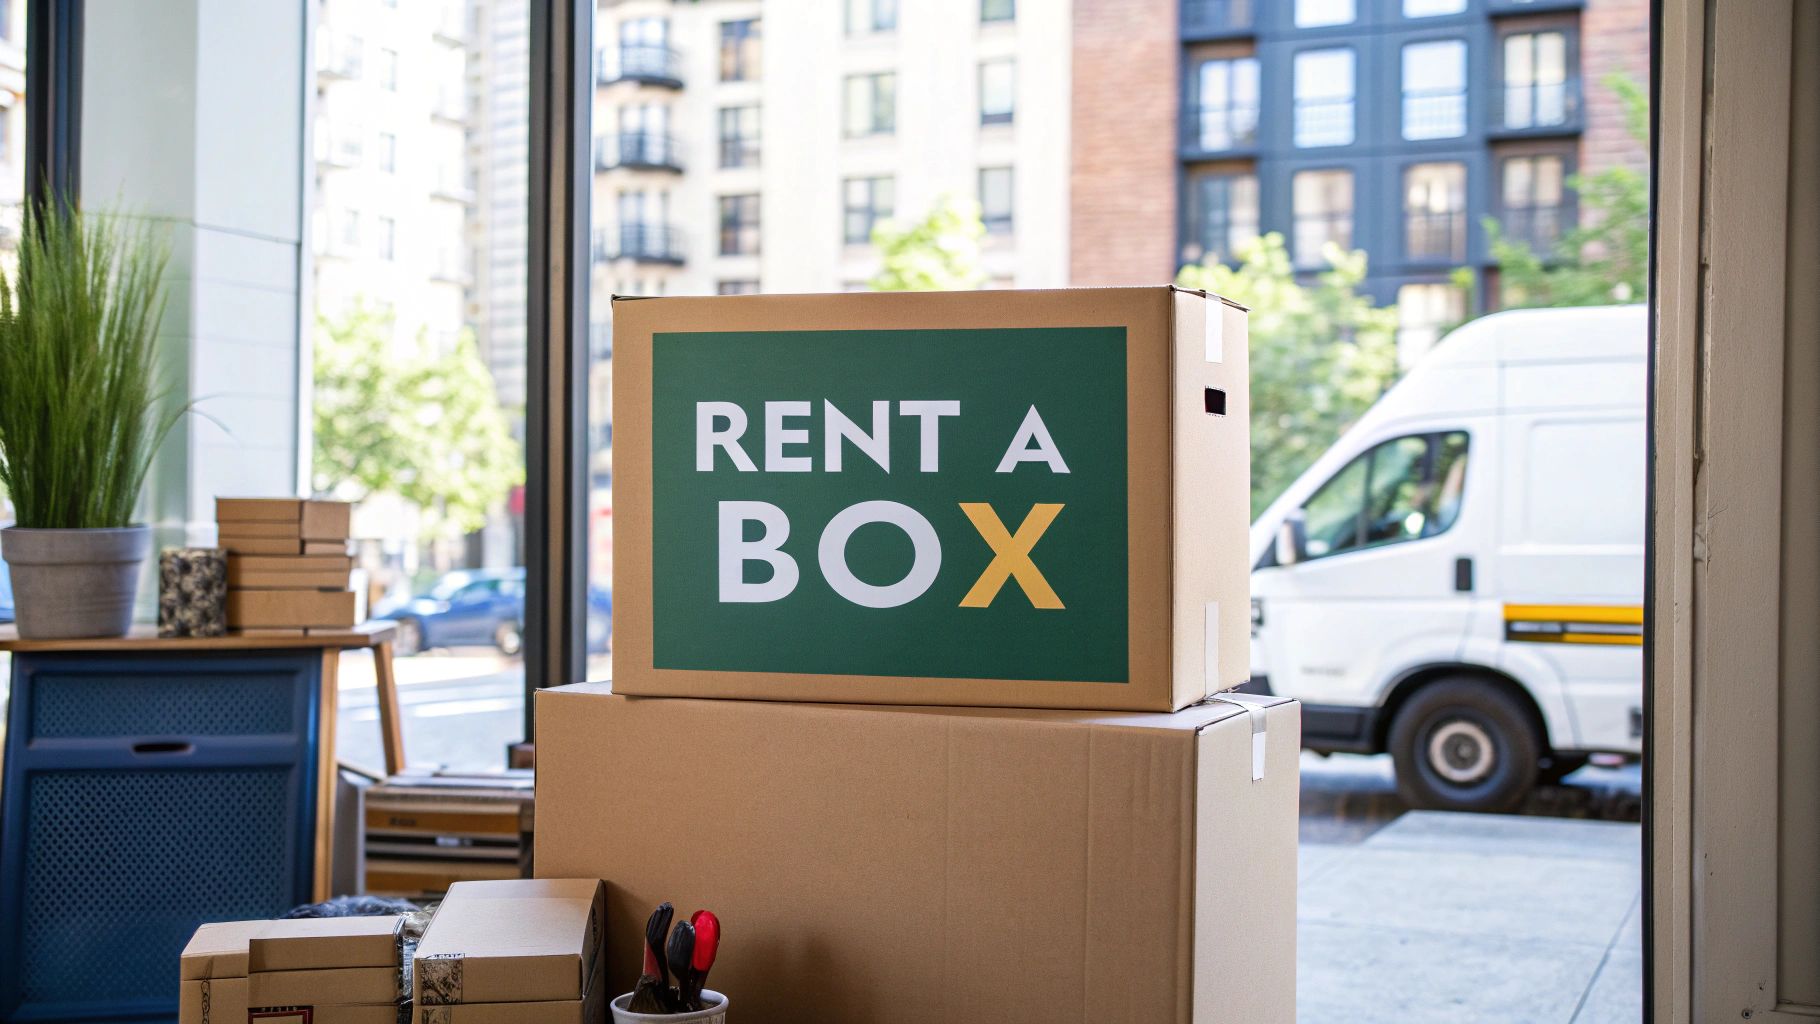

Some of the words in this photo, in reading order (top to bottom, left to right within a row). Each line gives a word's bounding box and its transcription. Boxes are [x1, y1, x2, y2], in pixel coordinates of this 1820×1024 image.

[696, 399, 960, 474] RENT
[995, 404, 1071, 474] A
[719, 500, 1066, 609] BOX
